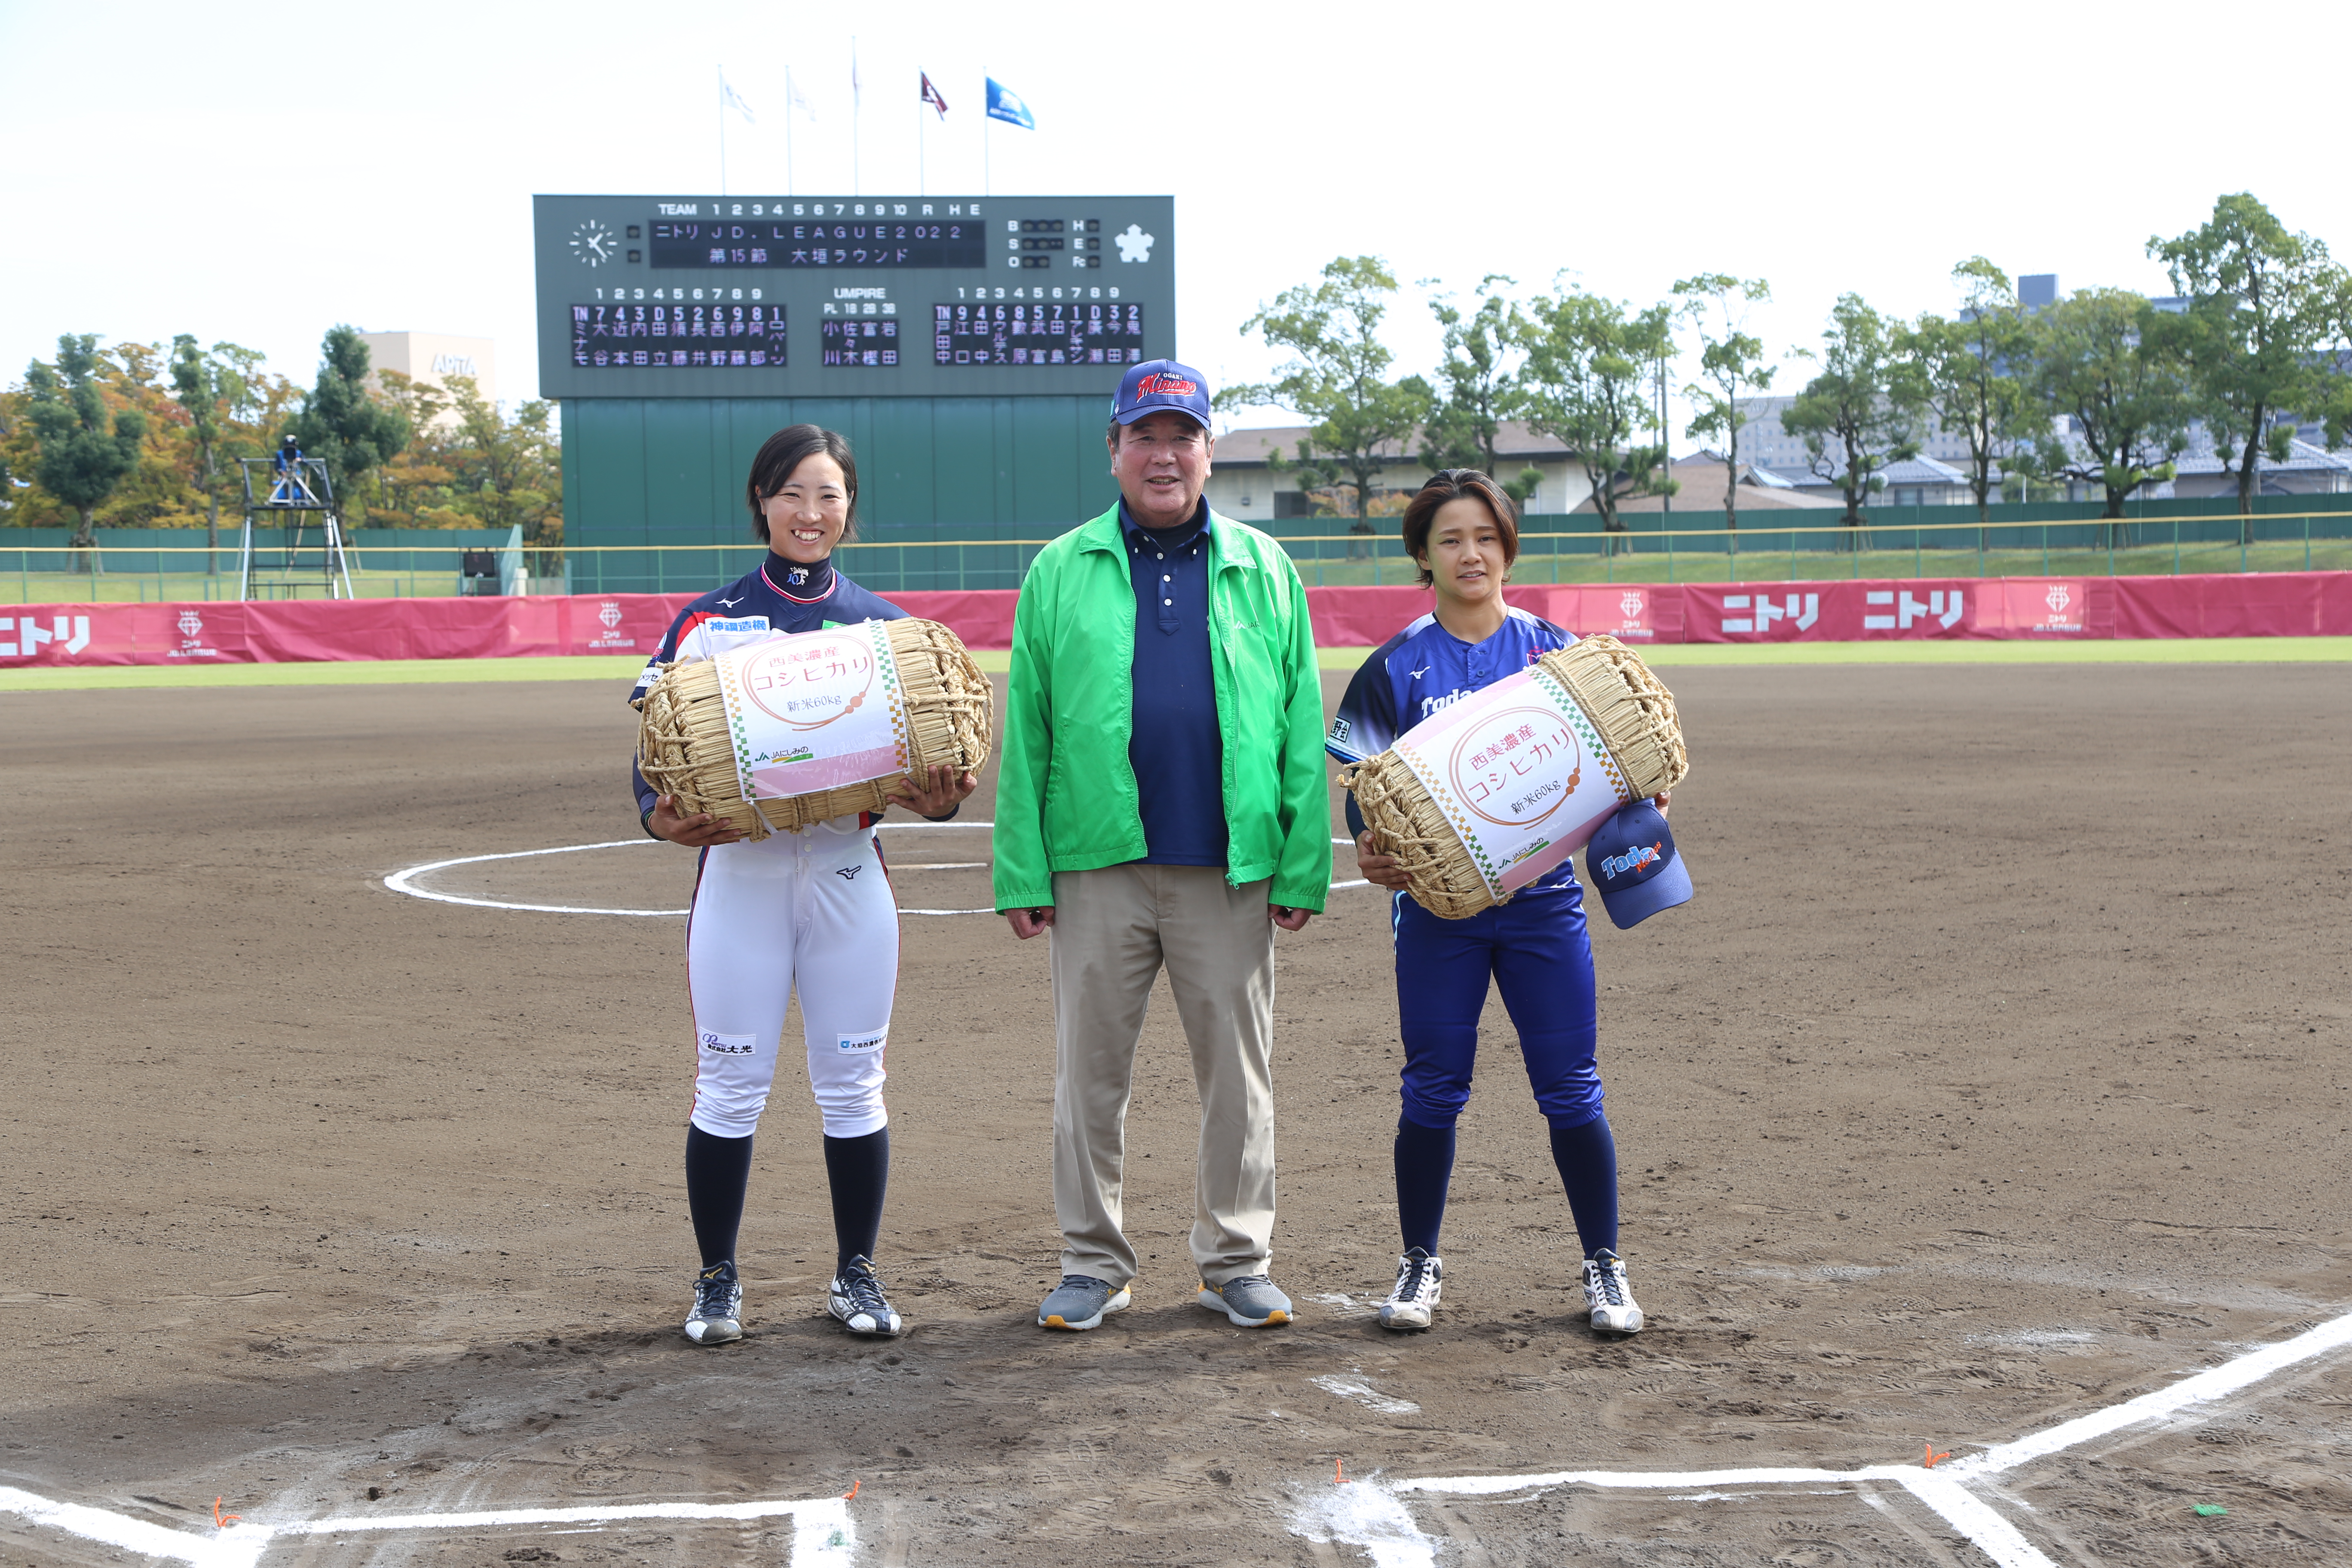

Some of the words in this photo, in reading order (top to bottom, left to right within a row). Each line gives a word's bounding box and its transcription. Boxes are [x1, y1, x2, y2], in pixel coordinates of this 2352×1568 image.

[658, 204, 697, 215] TEAM
[713, 204, 719, 214] 1
[732, 204, 742, 215] 2
[753, 204, 763, 215] 3
[773, 205, 783, 214] 4
[794, 204, 804, 215] 5
[814, 204, 824, 215] 6
[834, 204, 844, 215] 7
[855, 204, 865, 215] 8
[875, 205, 885, 215] 9
[894, 205, 906, 215] 10
[923, 205, 933, 214] R
[949, 205, 960, 214] H
[970, 204, 980, 215] E
[1008, 220, 1018, 231] B
[1073, 220, 1084, 230] H
[656, 224, 698, 239] ニトリ
[1009, 239, 1018, 249] S
[1074, 238, 1083, 249] E
[710, 248, 766, 262] 第15節
[791, 248, 908, 263] 大垣ラウンド
[1008, 257, 1019, 267] O
[596, 288, 602, 299] 1
[615, 288, 625, 299] 2
[634, 288, 644, 299] 3
[653, 288, 664, 299] 4
[674, 288, 683, 299] 5
[693, 288, 703, 299] 6
[712, 288, 722, 299] 7
[732, 288, 742, 299] 8
[752, 288, 762, 299] 9
[824, 303, 838, 314] PL
[844, 303, 857, 314] 1B
[863, 303, 876, 314] 2B
[882, 303, 896, 314] 3B
[834, 288, 885, 299] UMPIRE
[959, 288, 964, 298] 1
[976, 288, 986, 298] 2
[995, 288, 1004, 298] 3
[1014, 288, 1024, 297] 4
[1033, 288, 1043, 298] 5
[1053, 288, 1062, 298] 6
[1071, 288, 1081, 298] 7
[1090, 287, 1100, 298] 8
[1109, 287, 1119, 298] 9
[595, 306, 606, 321] 7
[615, 306, 625, 321] 4
[634, 306, 645, 322] 3
[654, 306, 664, 322] D
[674, 306, 684, 322] 5
[693, 306, 704, 321] 2
[713, 306, 723, 321] 6
[733, 306, 743, 321] 9
[752, 306, 762, 321] 8
[773, 306, 779, 321] 1
[958, 306, 967, 320] 9
[977, 306, 986, 320] 4
[995, 305, 1005, 320] 6
[1014, 305, 1024, 320] 8
[1034, 305, 1044, 320] 5
[1053, 305, 1063, 319] 7
[1073, 305, 1079, 319] 1
[1091, 305, 1100, 320] D
[1109, 305, 1119, 320] 3
[1128, 305, 1138, 319] 2
[573, 322, 588, 365] ミナモ
[592, 321, 609, 366] 大谷
[612, 321, 629, 365] 近本
[631, 322, 648, 365] 内田
[652, 322, 668, 366] 田立
[691, 322, 707, 365] 長井
[710, 322, 727, 365] 西野
[729, 322, 746, 365] 伊藤
[749, 322, 766, 365] 阿部
[824, 321, 840, 365] 小川
[843, 321, 859, 365] 佐々木
[881, 321, 897, 364] 岩田
[935, 321, 951, 364] 戸田中
[955, 320, 970, 364] 江口
[974, 321, 989, 364] 田中
[1031, 320, 1047, 364] 武富
[1050, 320, 1065, 364] 田島
[1106, 320, 1122, 363] 今田
[1136, 373, 1196, 403] Minamo
[1723, 595, 1818, 631] ニトリ
[1865, 592, 1963, 628] ニトリ
[754, 655, 869, 691] コシヒカリ
[769, 646, 840, 668] 西美濃産
[787, 695, 842, 714] 新米60kg
[771, 746, 808, 759] JAにしみの
[1468, 728, 1570, 803] コシヒカリ
[1469, 723, 1537, 772] 西美濃産
[1510, 779, 1562, 815] 新米60kg
[1512, 837, 1544, 861] JAにしみの
[1601, 845, 1661, 880] Toda
[1635, 841, 1662, 873] Medics
